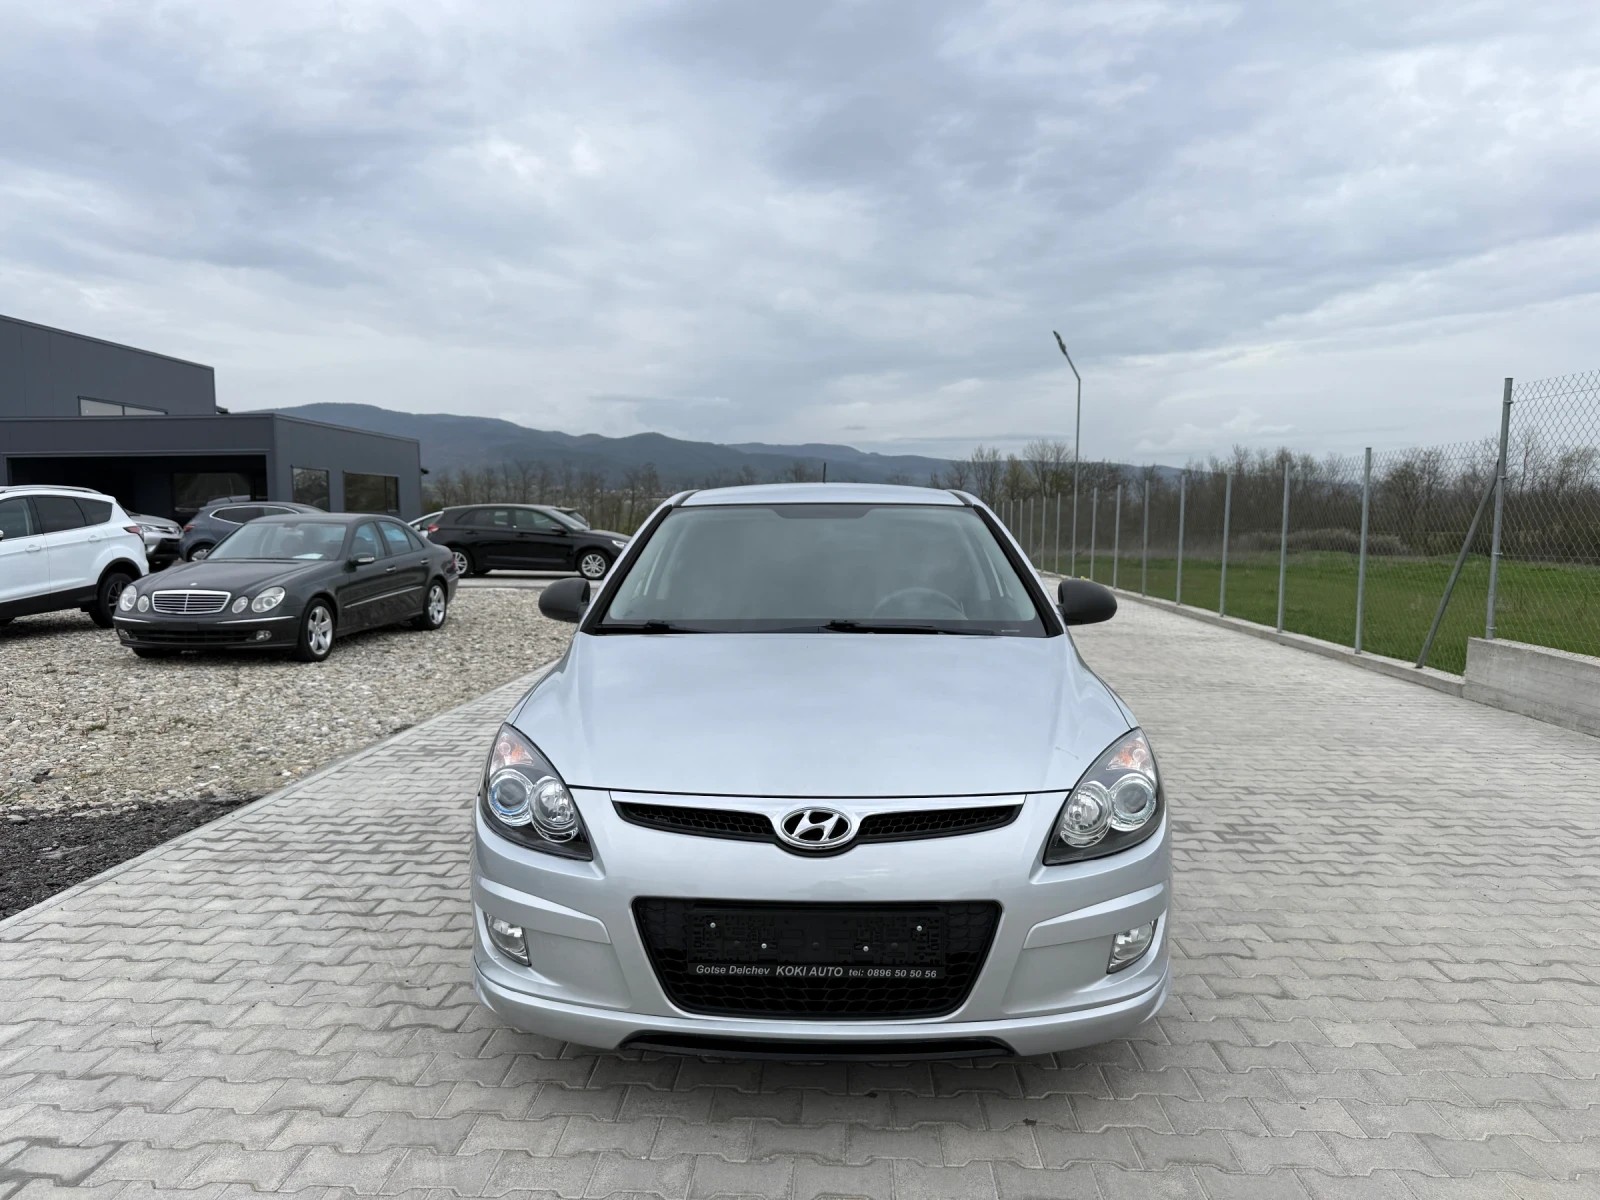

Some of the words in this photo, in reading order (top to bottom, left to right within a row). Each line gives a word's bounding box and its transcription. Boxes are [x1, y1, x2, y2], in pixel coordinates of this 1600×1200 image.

[696, 964, 726, 974] Gotse
[729, 965, 771, 975] Delchev
[775, 965, 807, 976] KOKI
[808, 966, 843, 977] AUTO
[848, 968, 864, 977] tel:
[867, 968, 892, 977] 0896
[894, 969, 907, 978] 50
[909, 969, 922, 978] 50
[924, 970, 937, 978] 56
